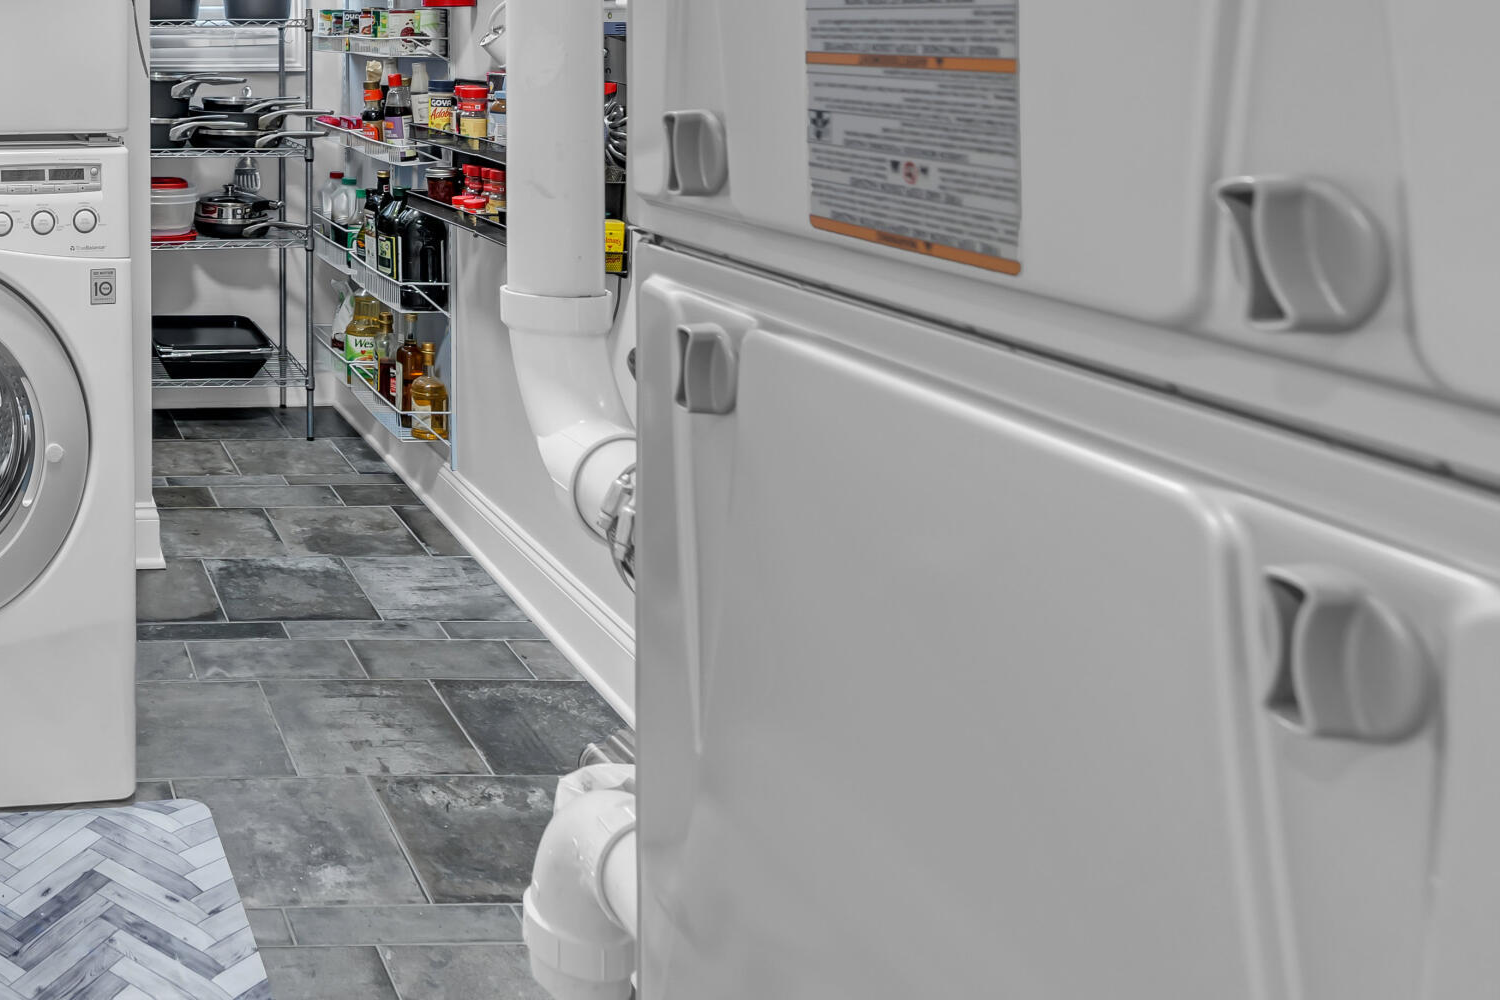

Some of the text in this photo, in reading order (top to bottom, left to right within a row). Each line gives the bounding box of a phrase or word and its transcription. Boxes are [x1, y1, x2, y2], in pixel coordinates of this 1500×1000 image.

[431, 99, 452, 107] GOYA
[94, 281, 113, 297] 10
[354, 337, 374, 348] Wes
